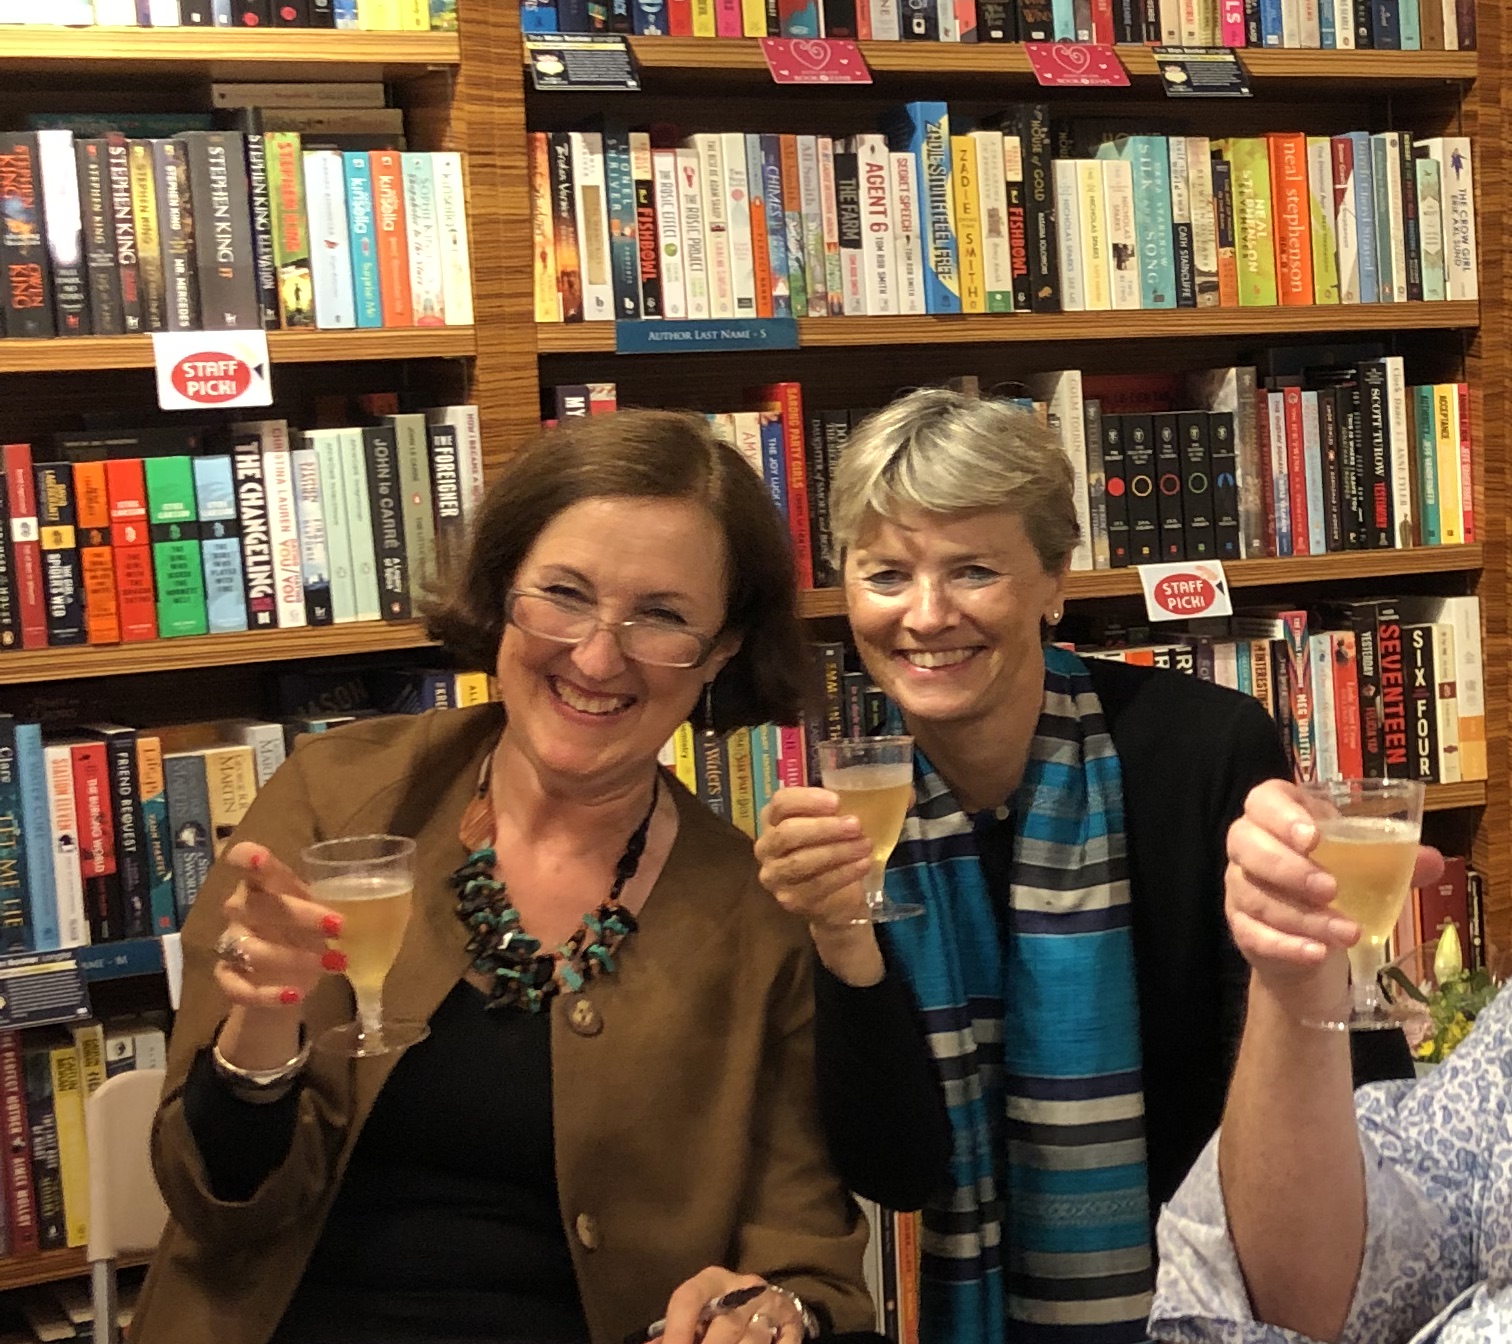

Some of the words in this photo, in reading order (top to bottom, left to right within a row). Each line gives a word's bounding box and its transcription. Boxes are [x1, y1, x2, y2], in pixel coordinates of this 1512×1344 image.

[925, 120, 945, 162] ZADIE
[1283, 142, 1302, 181] neal
[0, 154, 19, 199] KING
[14, 145, 35, 208] STEPHEN
[109, 147, 134, 219] STEPHEN
[207, 146, 229, 217] STEPHEN
[248, 134, 268, 193] STEPHEN
[1138, 144, 1153, 190] SILK
[89, 164, 102, 211] STEPHEN
[164, 165, 178, 206] STEPHEN
[866, 163, 887, 217] AGENT
[927, 163, 946, 213] SMITH
[1458, 189, 1467, 207] THE
[94, 216, 105, 243] KING
[171, 208, 181, 230] KING
[254, 196, 270, 230] KING
[870, 223, 889, 232] 6
[934, 215, 949, 247] FEEL
[1254, 199, 1266, 239] NEAL
[1460, 210, 1468, 245] CROW
[117, 223, 136, 264] KING
[217, 222, 234, 262] KING
[638, 208, 657, 282] FISHBOWL
[875, 237, 886, 251] TOM
[1009, 208, 1026, 278] FISHBOWL
[1178, 226, 1189, 247] CATH
[1283, 188, 1304, 293] stephenson
[175, 259, 184, 275] MR.
[219, 268, 233, 279] IT
[258, 234, 275, 289] ELEVATION
[876, 255, 886, 268] ROB
[936, 249, 952, 281] FREE
[1145, 231, 1158, 284] SONG
[1179, 250, 1192, 297] STAINCLIFFE
[1462, 248, 1470, 272] GIRL
[8, 264, 29, 309] KING
[28, 263, 43, 306] OWEN
[176, 278, 190, 327] MERCEDES
[878, 272, 887, 294] SMITH
[648, 331, 693, 340] AUTHOR
[695, 330, 718, 339] LAST
[721, 330, 750, 338] NAME
[760, 329, 766, 338] S
[182, 360, 238, 378] STAFF
[186, 380, 237, 396] PICK!
[1371, 388, 1382, 427] SCOTT
[235, 441, 261, 479] THE
[272, 428, 287, 485] CHRISTINA
[373, 439, 390, 478] JOHN
[1373, 430, 1385, 476] TUROW
[378, 482, 392, 494] le
[435, 447, 459, 517] FOREIGNER
[278, 490, 291, 532] LAUREN
[381, 498, 399, 548] CARRÉ
[1374, 482, 1387, 528] TESTIMONY
[239, 482, 274, 597] CHANGELING
[1162, 580, 1203, 595] STAFF
[1167, 596, 1205, 610] PICK!
[1412, 630, 1426, 687] SIX
[1380, 624, 1407, 764] SEVENTEEN
[1416, 699, 1430, 775] FOUR
[52, 758, 70, 795] STATION
[87, 779, 97, 793] THE
[116, 752, 130, 795] FRIEND
[220, 755, 236, 813] MARTIN
[56, 799, 73, 831] ELEVEN
[88, 796, 102, 837] BURNING
[120, 800, 136, 853] REQUEST
[92, 840, 105, 873] WORLD
[3, 1051, 18, 1092] PERFECT
[8, 1096, 22, 1135] MOTHER
[11, 1157, 26, 1187] AIMEE
[17, 1189, 31, 1227] MOLLOY
